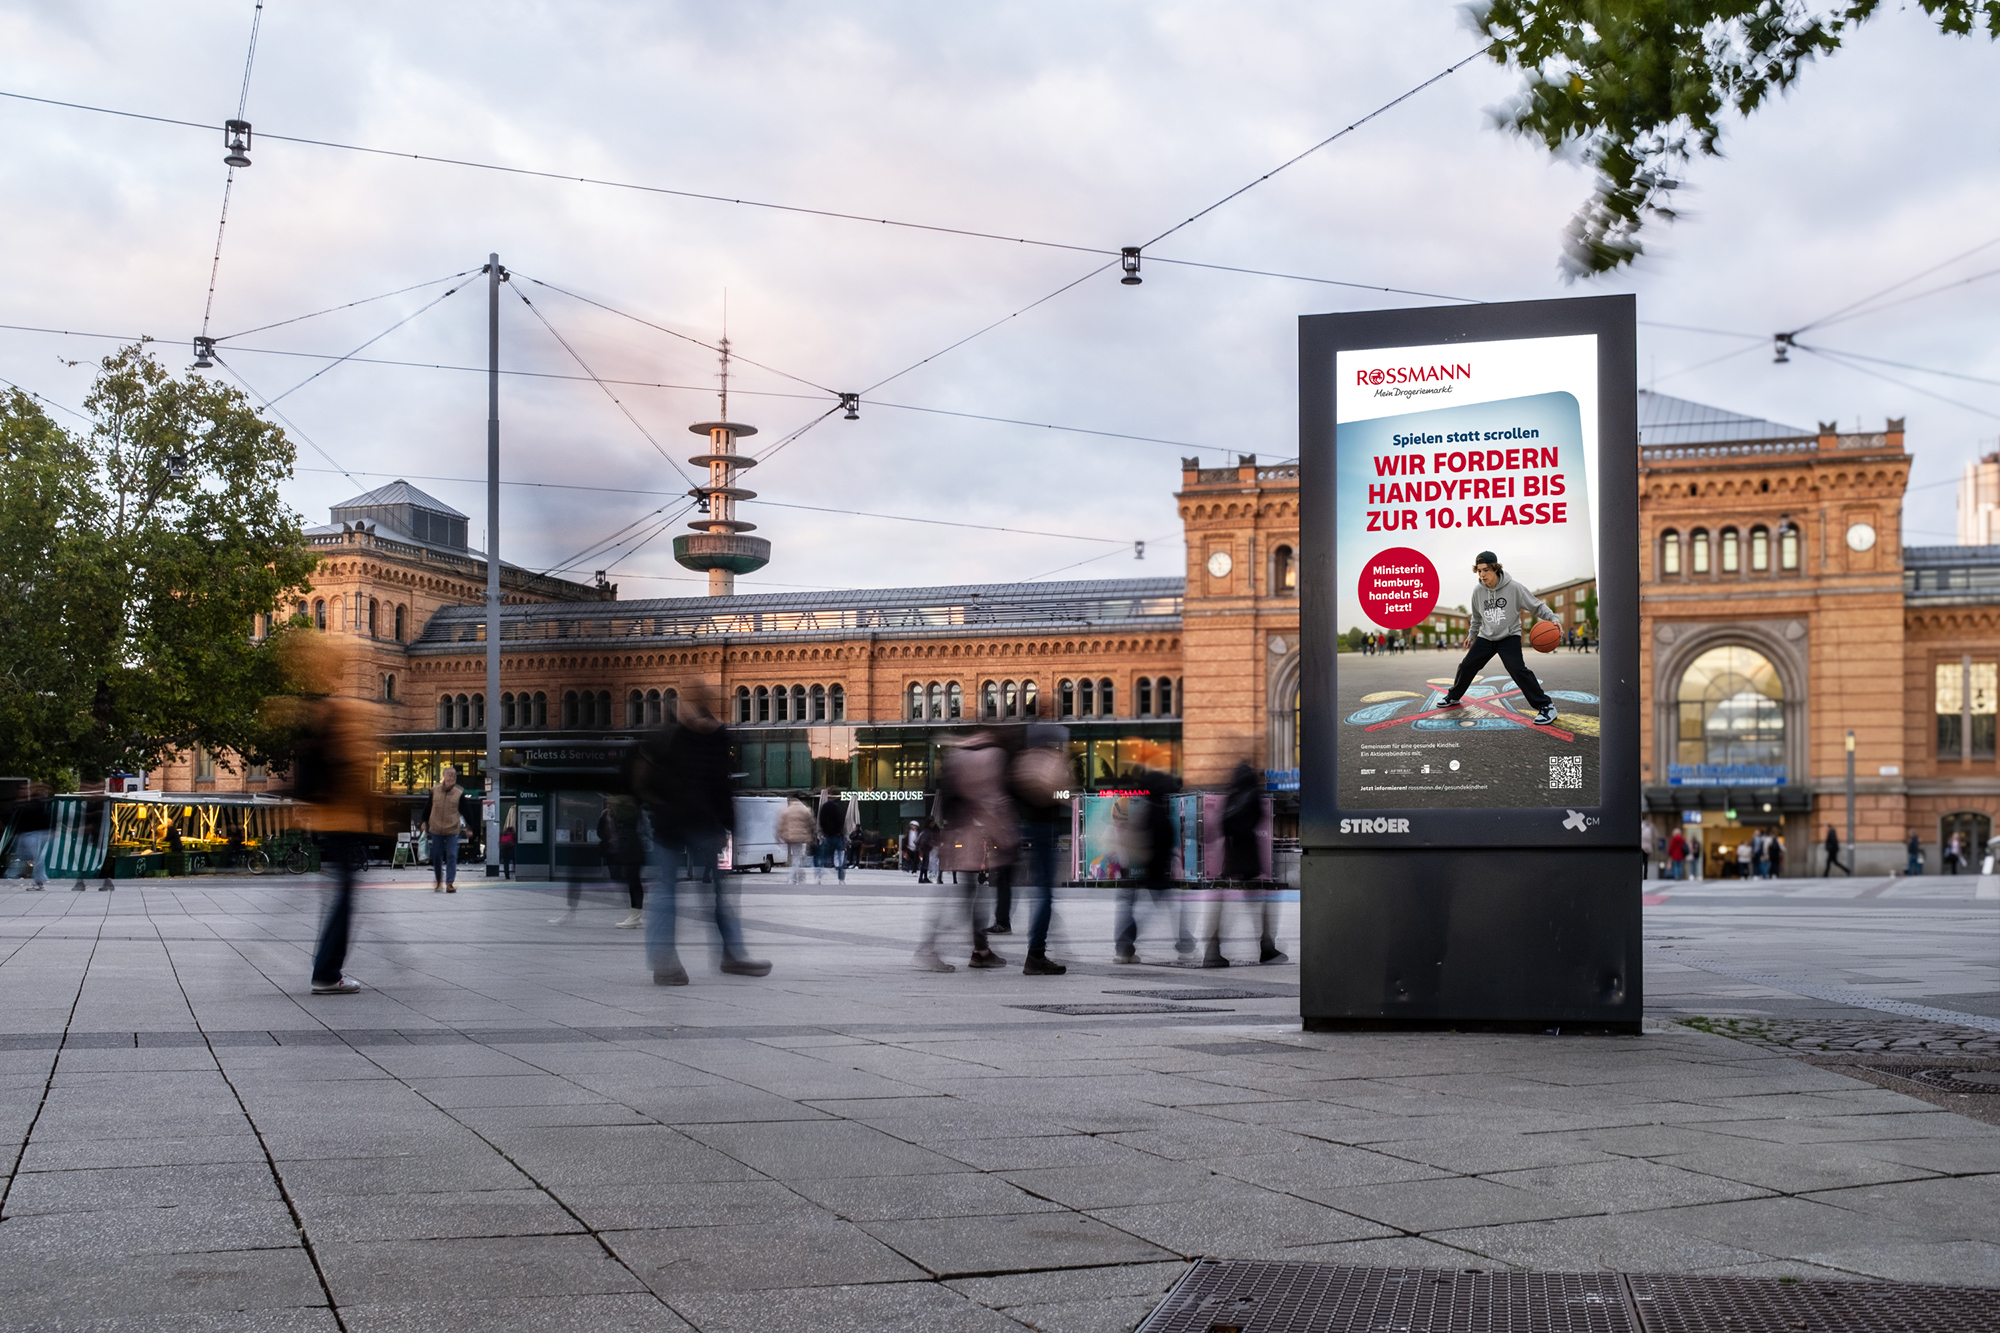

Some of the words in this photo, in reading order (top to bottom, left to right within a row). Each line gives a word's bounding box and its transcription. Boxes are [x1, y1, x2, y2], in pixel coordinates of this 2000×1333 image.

[1356, 363, 1470, 386] ROSSMANN
[1374, 388, 1394, 398] Mein
[1394, 385, 1453, 399] Drogeriemarkt
[1392, 432, 1442, 448] Spielen
[1446, 430, 1480, 443] statt
[1484, 427, 1540, 441] scrollen
[1374, 454, 1426, 476] WIR
[1434, 446, 1559, 474] FORDERN
[1368, 476, 1515, 504] HANDYFREI
[1523, 474, 1566, 497] BIS
[1366, 509, 1418, 532] ZUR
[1425, 507, 1462, 529] 10.
[1467, 502, 1568, 528] KLASSE
[1373, 564, 1424, 576] Ministerin
[1374, 578, 1424, 588] Hamburg,
[1369, 590, 1411, 600] handeln
[1413, 589, 1429, 600] Sie
[1384, 602, 1412, 614] jetzt!
[526, 750, 558, 760] Tickets
[560, 750, 566, 760] &
[569, 750, 605, 760] Service
[890, 791, 923, 800] HOUSE
[1340, 817, 1410, 834] STRÖER
[1586, 817, 1600, 826] CM
